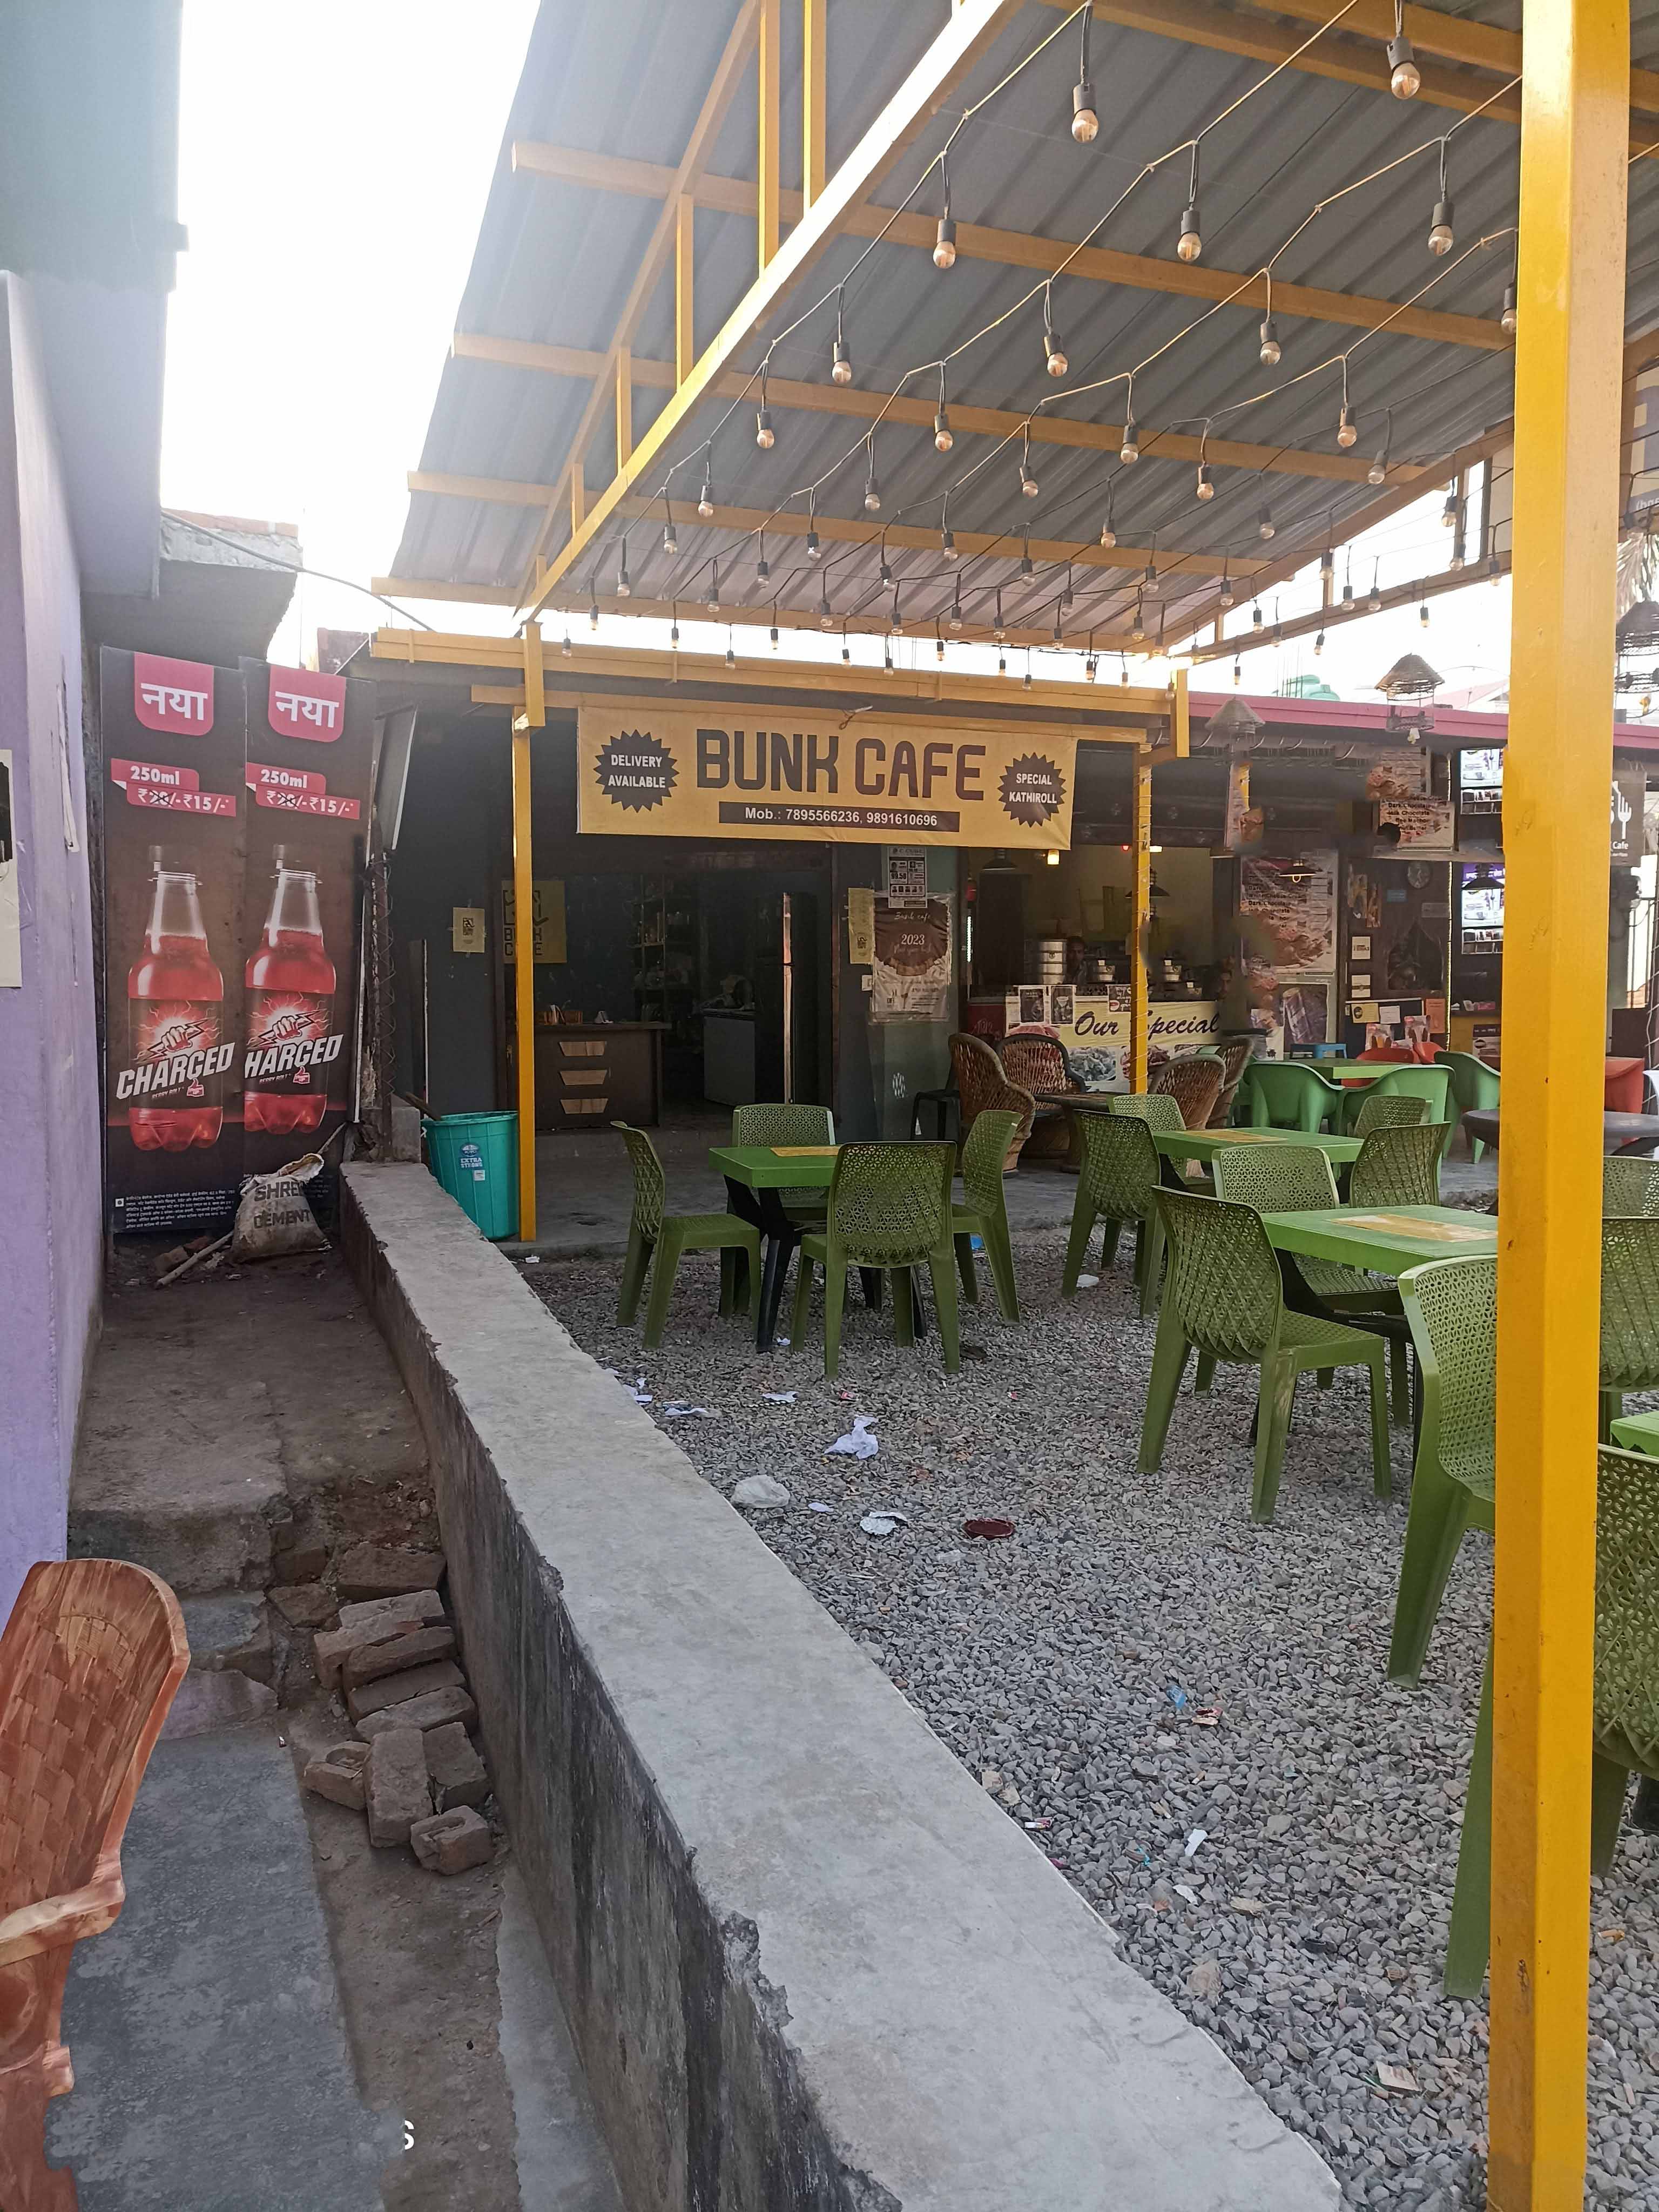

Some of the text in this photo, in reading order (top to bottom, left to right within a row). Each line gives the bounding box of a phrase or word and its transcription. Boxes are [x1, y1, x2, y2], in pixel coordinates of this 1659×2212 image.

[140, 683, 208, 720] नया
[275, 691, 340, 728] नया
[611, 754, 663, 767] DELIVERY
[696, 729, 986, 801] BUNK CAFE
[130, 765, 180, 785] 250ml
[260, 768, 308, 788] 250ml
[608, 774, 666, 788] AVAILABLE
[1016, 773, 1053, 785] SPECIAL
[1009, 791, 1057, 804] KATHIROLL
[786, 808, 863, 824] 7895566236,
[866, 812, 938, 826] 9891610696
[1612, 841, 1629, 849] Cafe
[901, 934, 925, 946] 2023
[1074, 1010, 1220, 1041] Our pecial
[245, 1034, 344, 1078] HARGED
[116, 1042, 235, 1100] CHARGED
